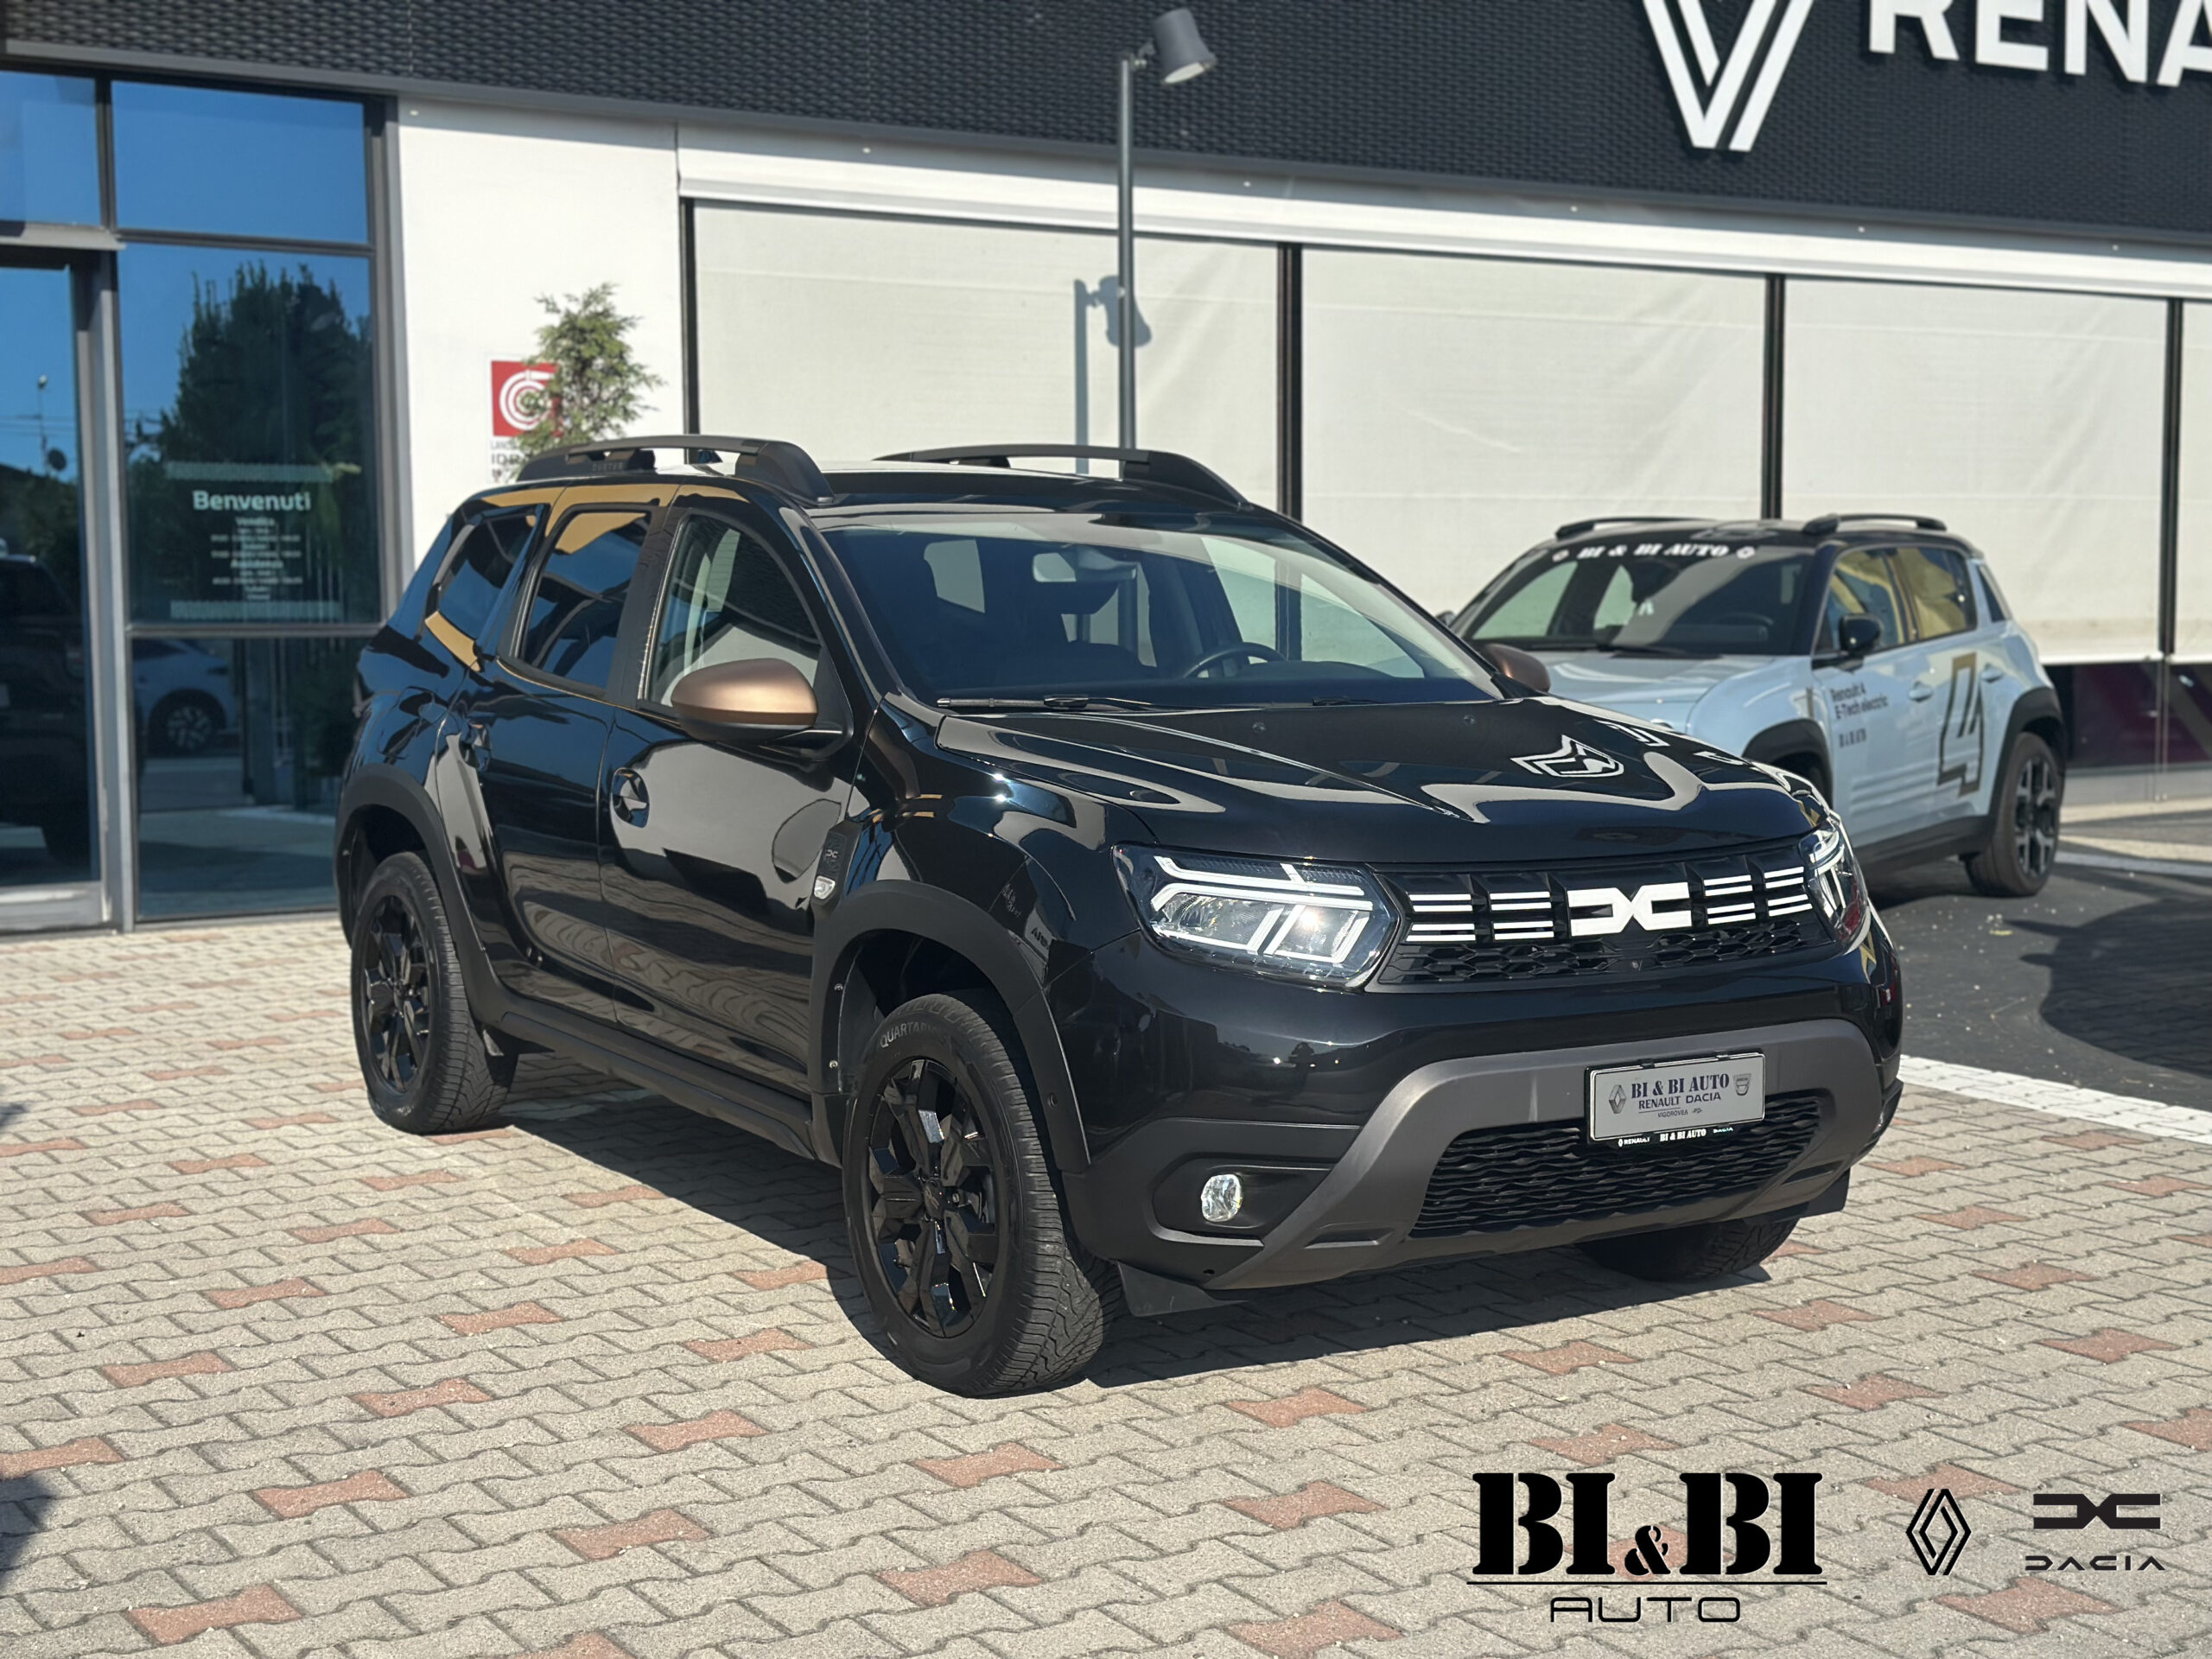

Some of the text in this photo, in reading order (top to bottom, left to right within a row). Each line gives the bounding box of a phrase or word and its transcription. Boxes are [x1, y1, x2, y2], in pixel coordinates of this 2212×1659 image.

[193, 490, 311, 511] Benvenuti
[1577, 543, 1730, 559] BI & BI AUTO
[1631, 1073, 1730, 1098] BI & BI AUTO
[1638, 1092, 1721, 1109] RENAULT DACIA
[1624, 1136, 1650, 1145] RENAULT
[1660, 1133, 1668, 1141] BI
[1669, 1132, 1676, 1141] &
[1676, 1131, 1685, 1140] BI
[1687, 1128, 1707, 1139] AUTO
